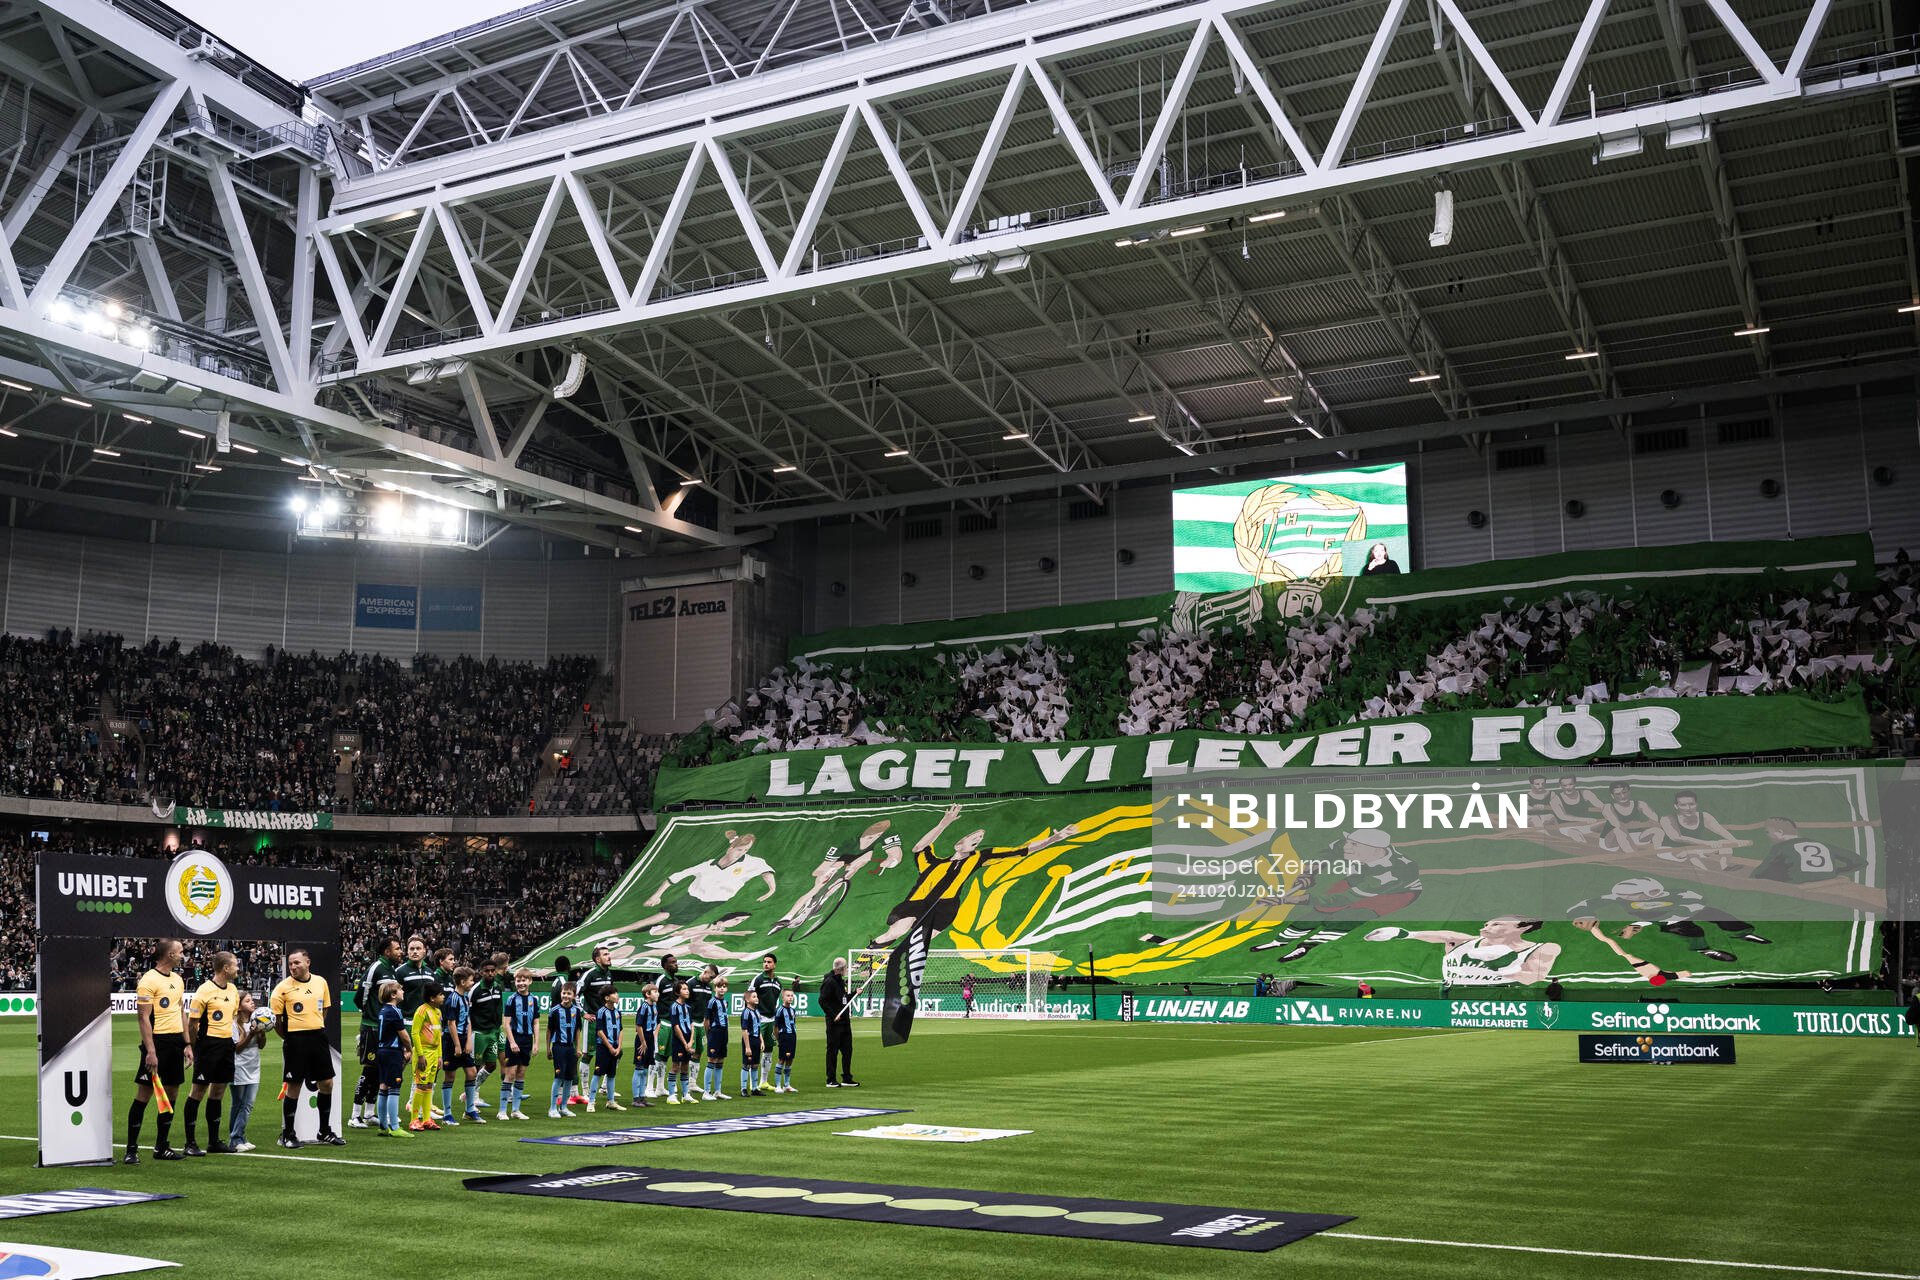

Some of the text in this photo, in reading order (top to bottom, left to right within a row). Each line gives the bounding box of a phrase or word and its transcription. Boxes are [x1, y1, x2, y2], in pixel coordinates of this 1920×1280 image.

[359, 597, 415, 608] AMERICAN
[366, 606, 415, 616] EXPRESS
[629, 596, 726, 620] TELE2 Arena
[766, 705, 1682, 797] LAGET VI LEVER FÖR
[1802, 845, 1826, 868] 3
[58, 872, 147, 899] UNIBET
[249, 883, 325, 907] UNIBET
[1123, 994, 1131, 1022] SELECT
[1145, 999, 1219, 1018] LINJEN
[1218, 1000, 1250, 1019] AB
[1275, 1000, 1334, 1022] RIVAL
[1339, 1007, 1422, 1020] RIVARE.NU
[1451, 1001, 1527, 1016] SASCHAS
[1451, 1018, 1528, 1029] FAMILJEARBETE
[1591, 1011, 1761, 1032] Sefina pantbank
[1793, 1011, 1891, 1035] TURLOCKS
[1594, 1043, 1720, 1059] Sefina pantbank
[64, 1070, 88, 1107] U
